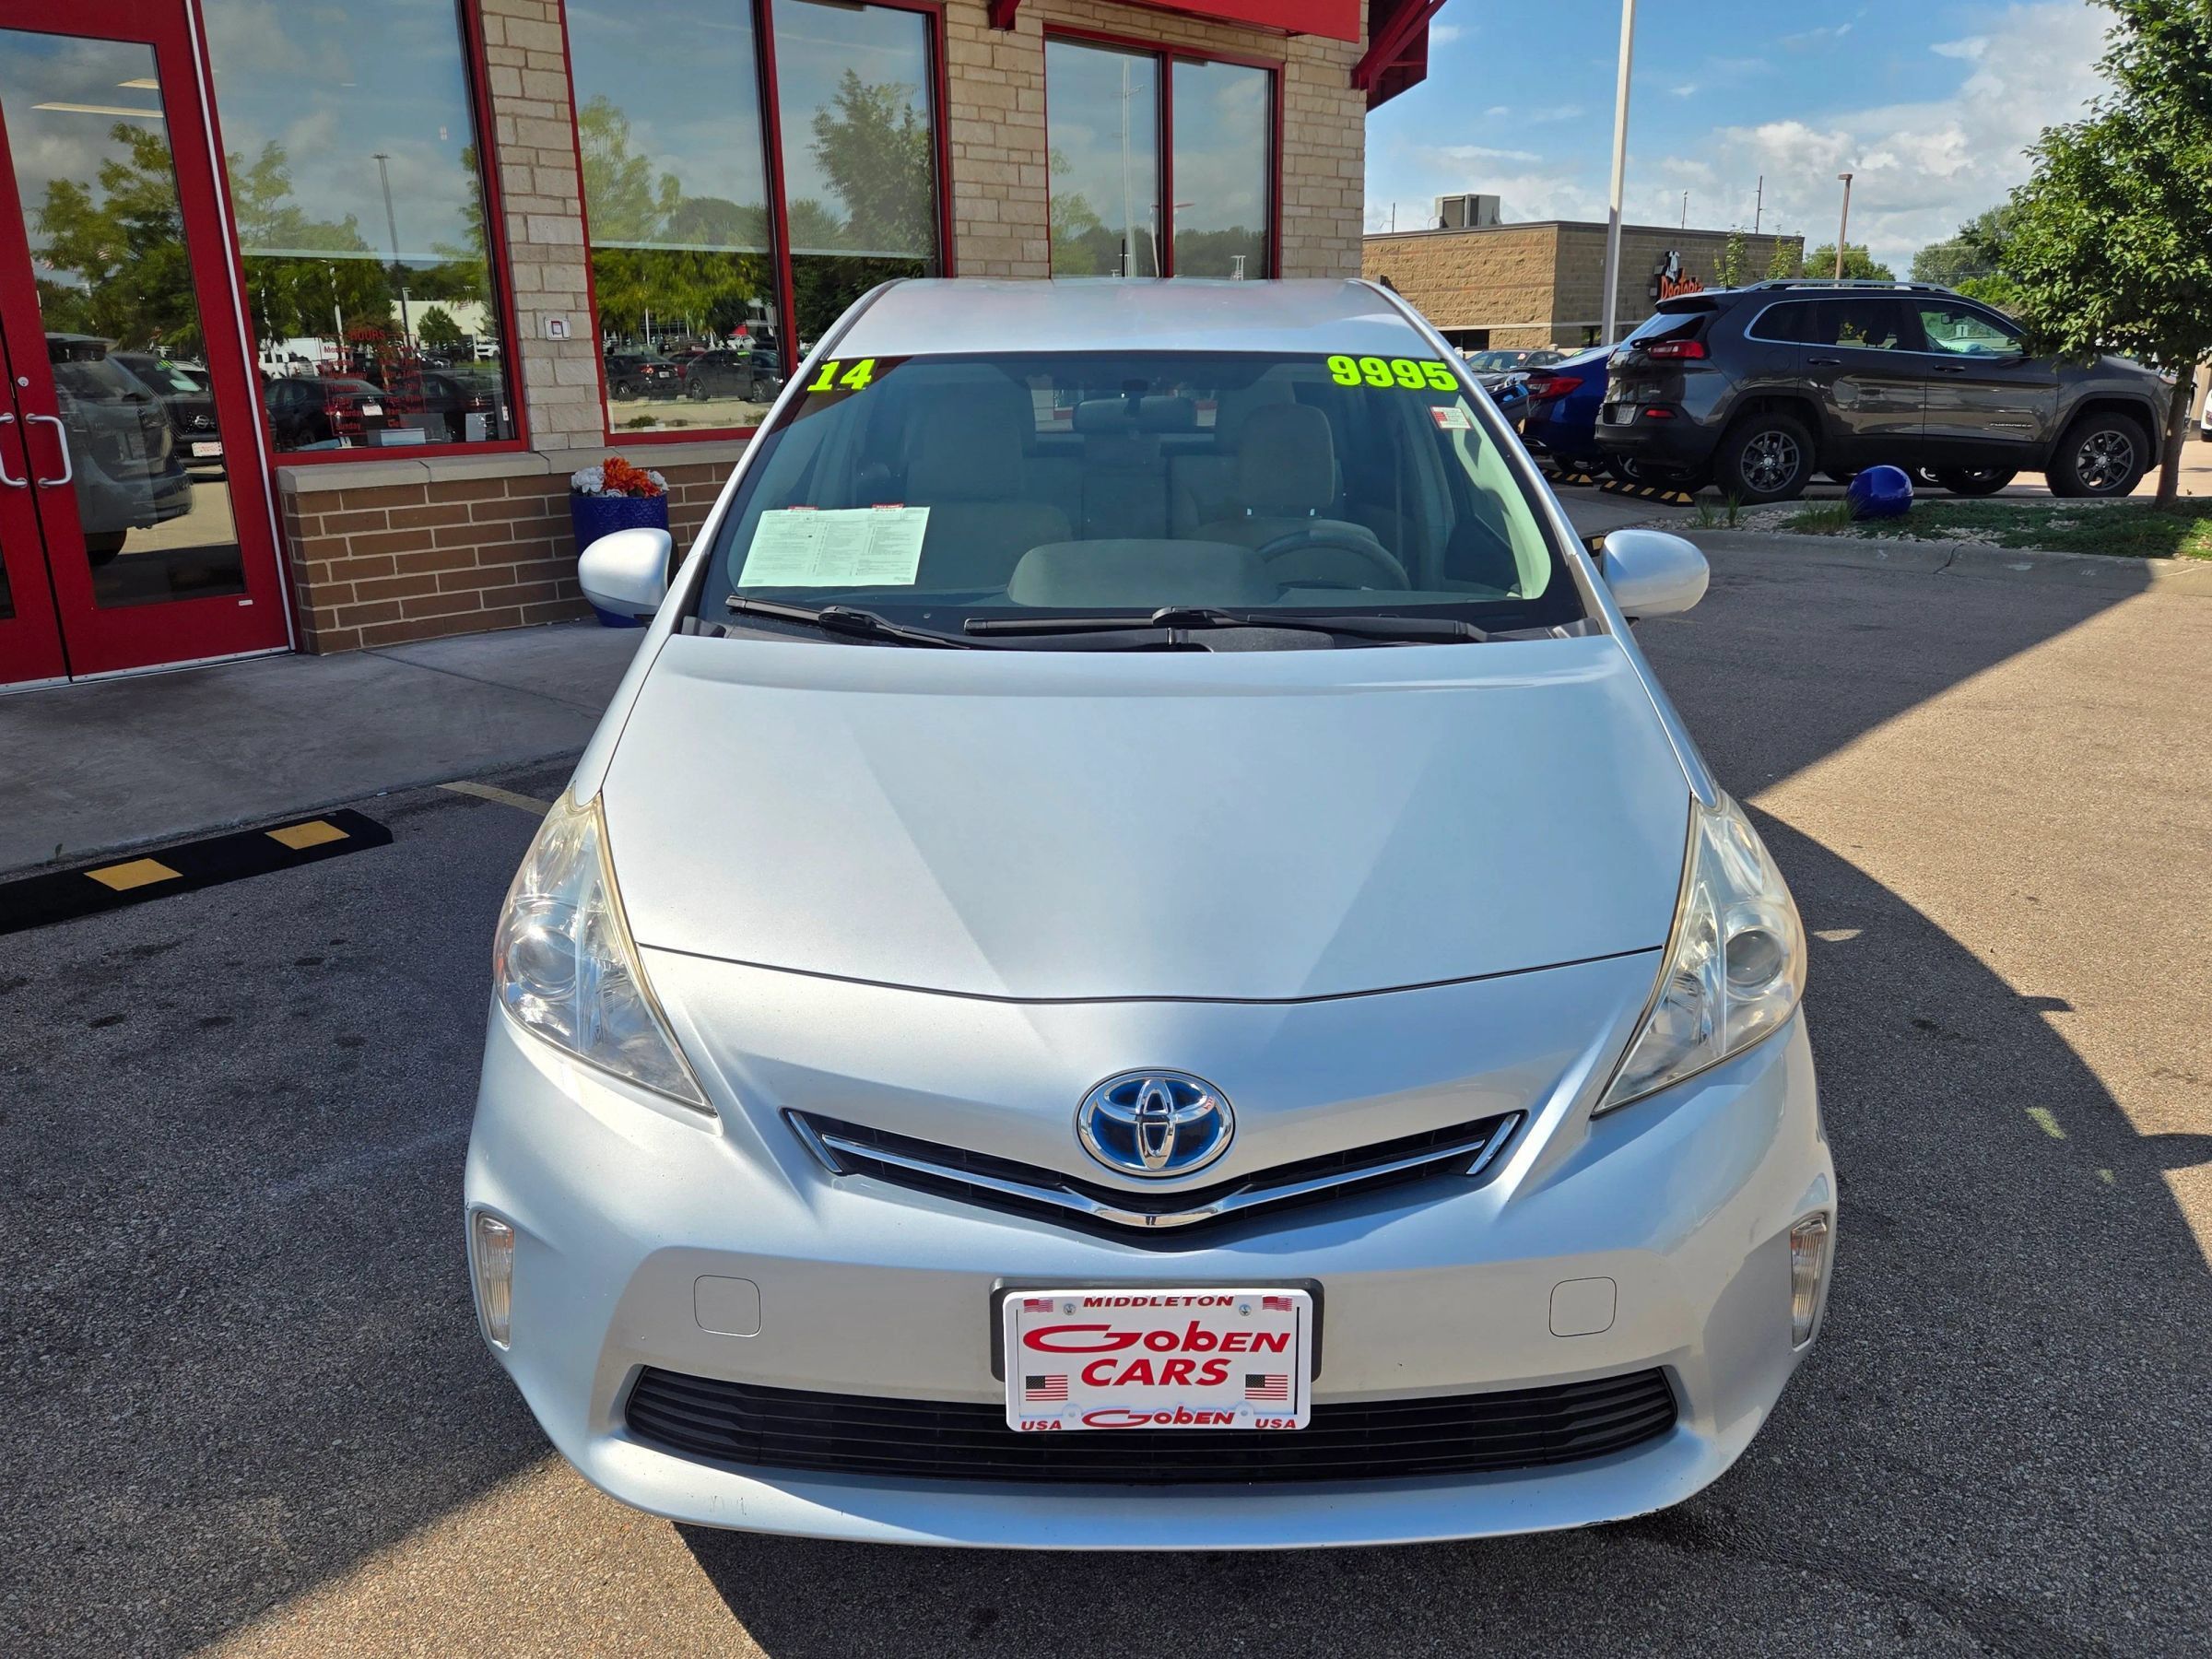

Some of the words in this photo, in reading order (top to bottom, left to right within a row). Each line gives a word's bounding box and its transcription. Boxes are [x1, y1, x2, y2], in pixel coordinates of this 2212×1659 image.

[350, 330, 385, 340] HOURS
[806, 359, 875, 392] 14
[1327, 355, 1459, 391] 9995
[1083, 1295, 1234, 1309] MIDDLETON
[1081, 1358, 1233, 1387] CARS
[1021, 1420, 1063, 1431] USA
[1254, 1418, 1296, 1430] USA
